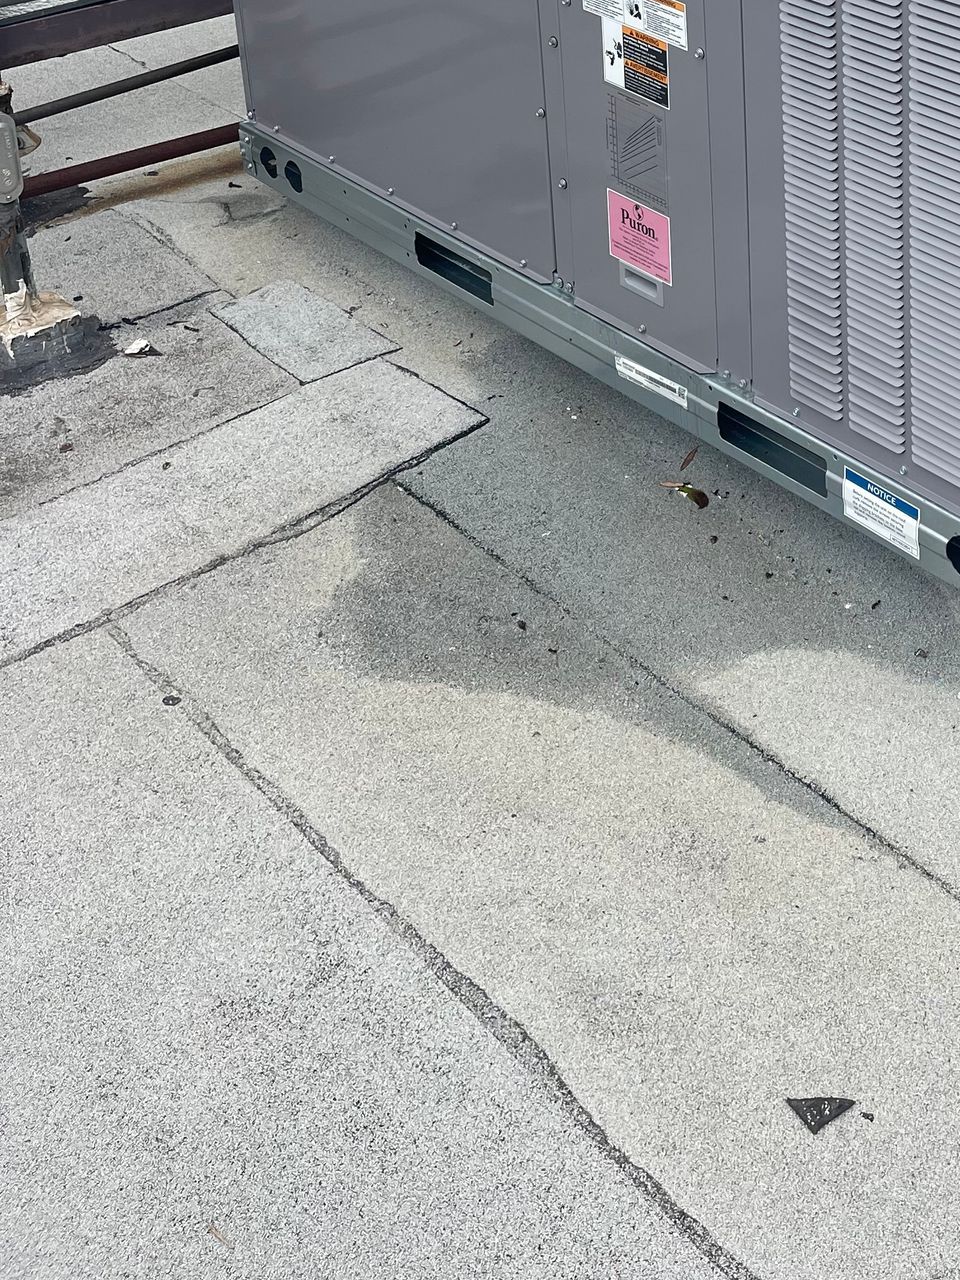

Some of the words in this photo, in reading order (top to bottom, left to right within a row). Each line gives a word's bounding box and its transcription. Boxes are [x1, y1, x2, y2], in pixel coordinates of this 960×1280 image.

[634, 30, 660, 47] WARNING
[620, 207, 656, 239] Puron
[867, 483, 897, 506] NOTICE
